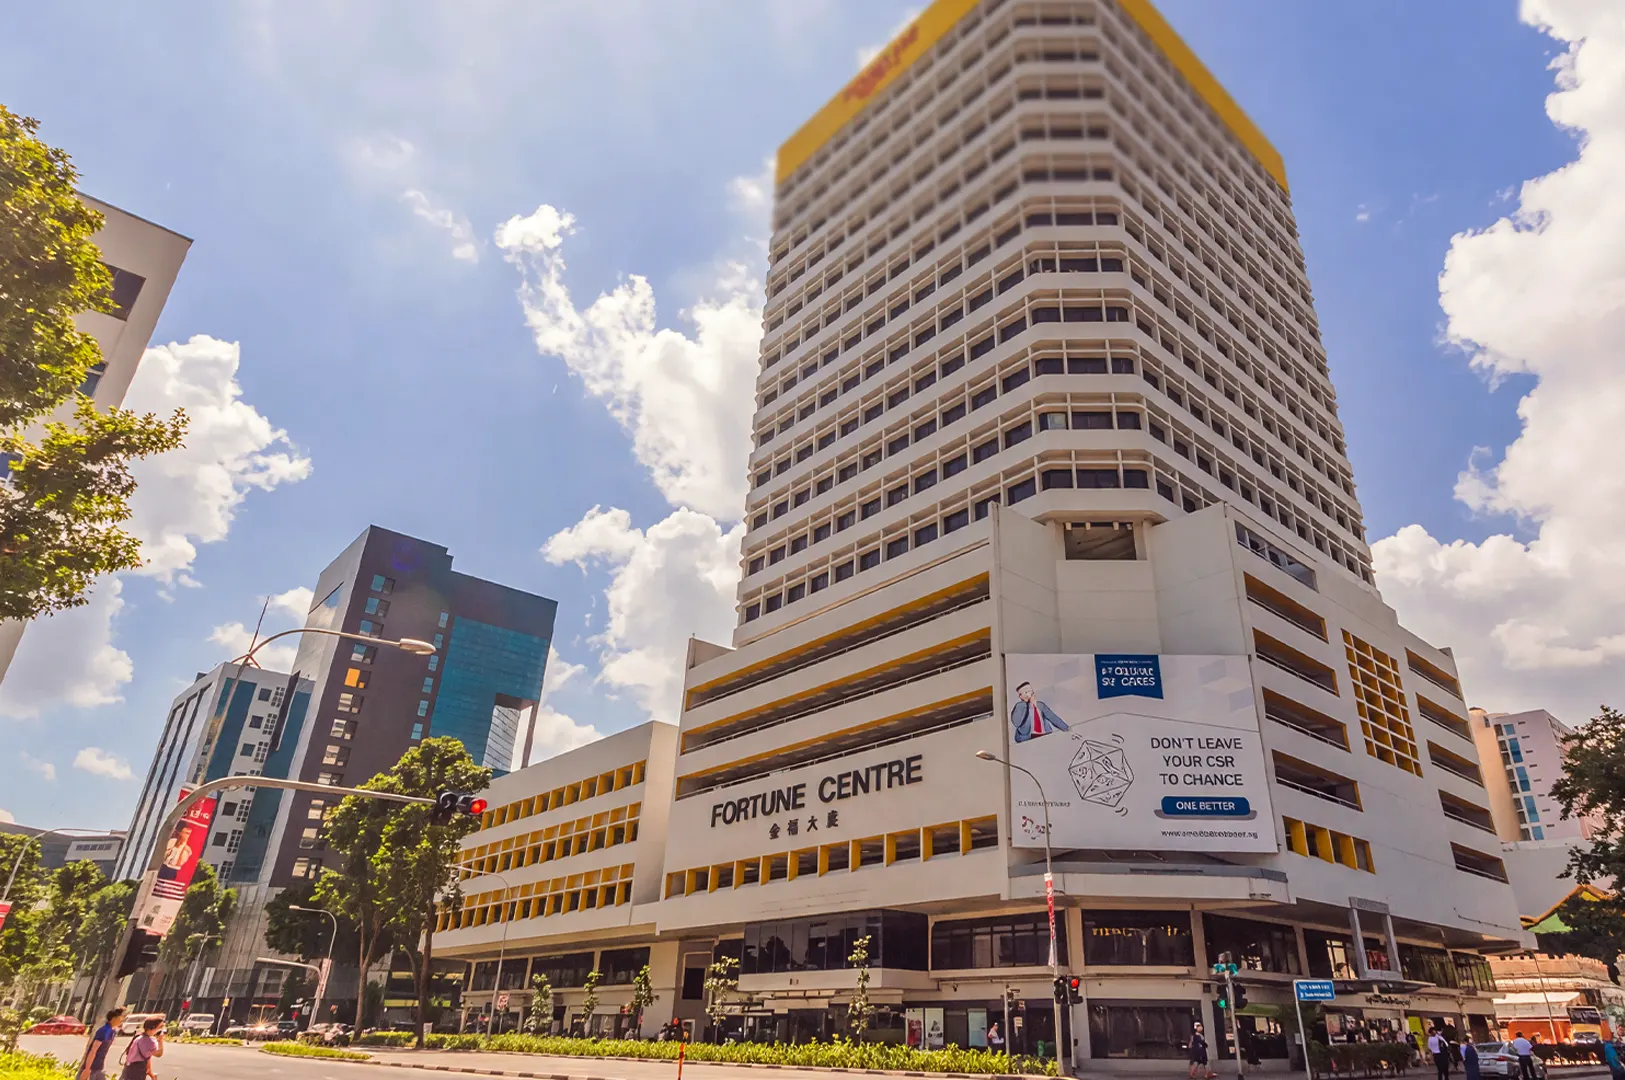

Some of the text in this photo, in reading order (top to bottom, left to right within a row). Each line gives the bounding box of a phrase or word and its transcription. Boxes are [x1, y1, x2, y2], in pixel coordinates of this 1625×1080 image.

[1150, 737, 1243, 750] DON'T LEAVE
[1162, 755, 1235, 768] YOUR CSR
[1159, 773, 1244, 786] TO CHANCE
[710, 754, 923, 828] FORTUNE CENTRE
[1175, 801, 1236, 811] ONE BETTER
